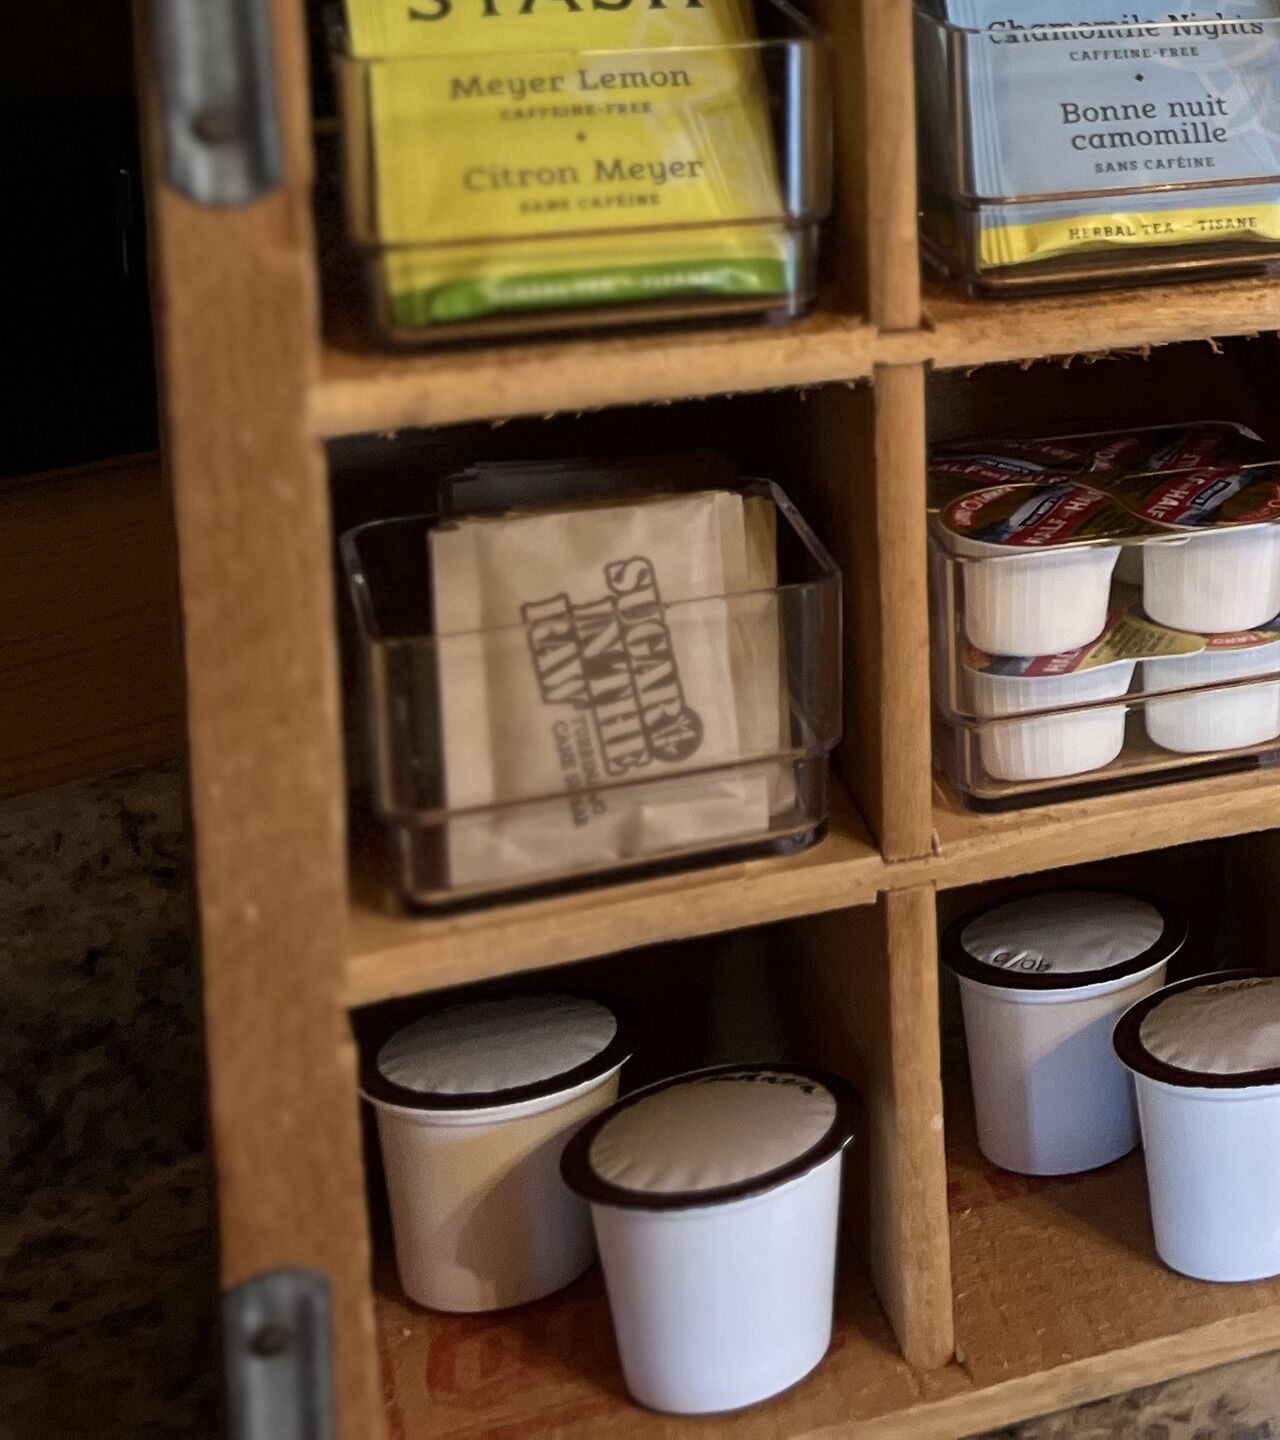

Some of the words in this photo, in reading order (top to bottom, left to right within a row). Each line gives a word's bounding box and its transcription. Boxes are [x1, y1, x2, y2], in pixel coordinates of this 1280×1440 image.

[1070, 46, 1200, 63] CAFFEINE-FREE
[450, 73, 565, 103] Meyer
[578, 66, 692, 92] Lemon
[1060, 101, 1158, 125] Bonne
[1167, 94, 1228, 119] nuit
[1070, 122, 1228, 152] camomille
[463, 162, 580, 192] Citron
[593, 157, 704, 192] Meyer
[1095, 161, 1139, 174] SANS
[1141, 222, 1175, 236] TEA
[1197, 216, 1259, 233] TISANE
[571, 595, 624, 662] IN
[605, 558, 690, 733] SUGAR
[521, 593, 593, 708] RAW
[588, 662, 655, 776] THE
